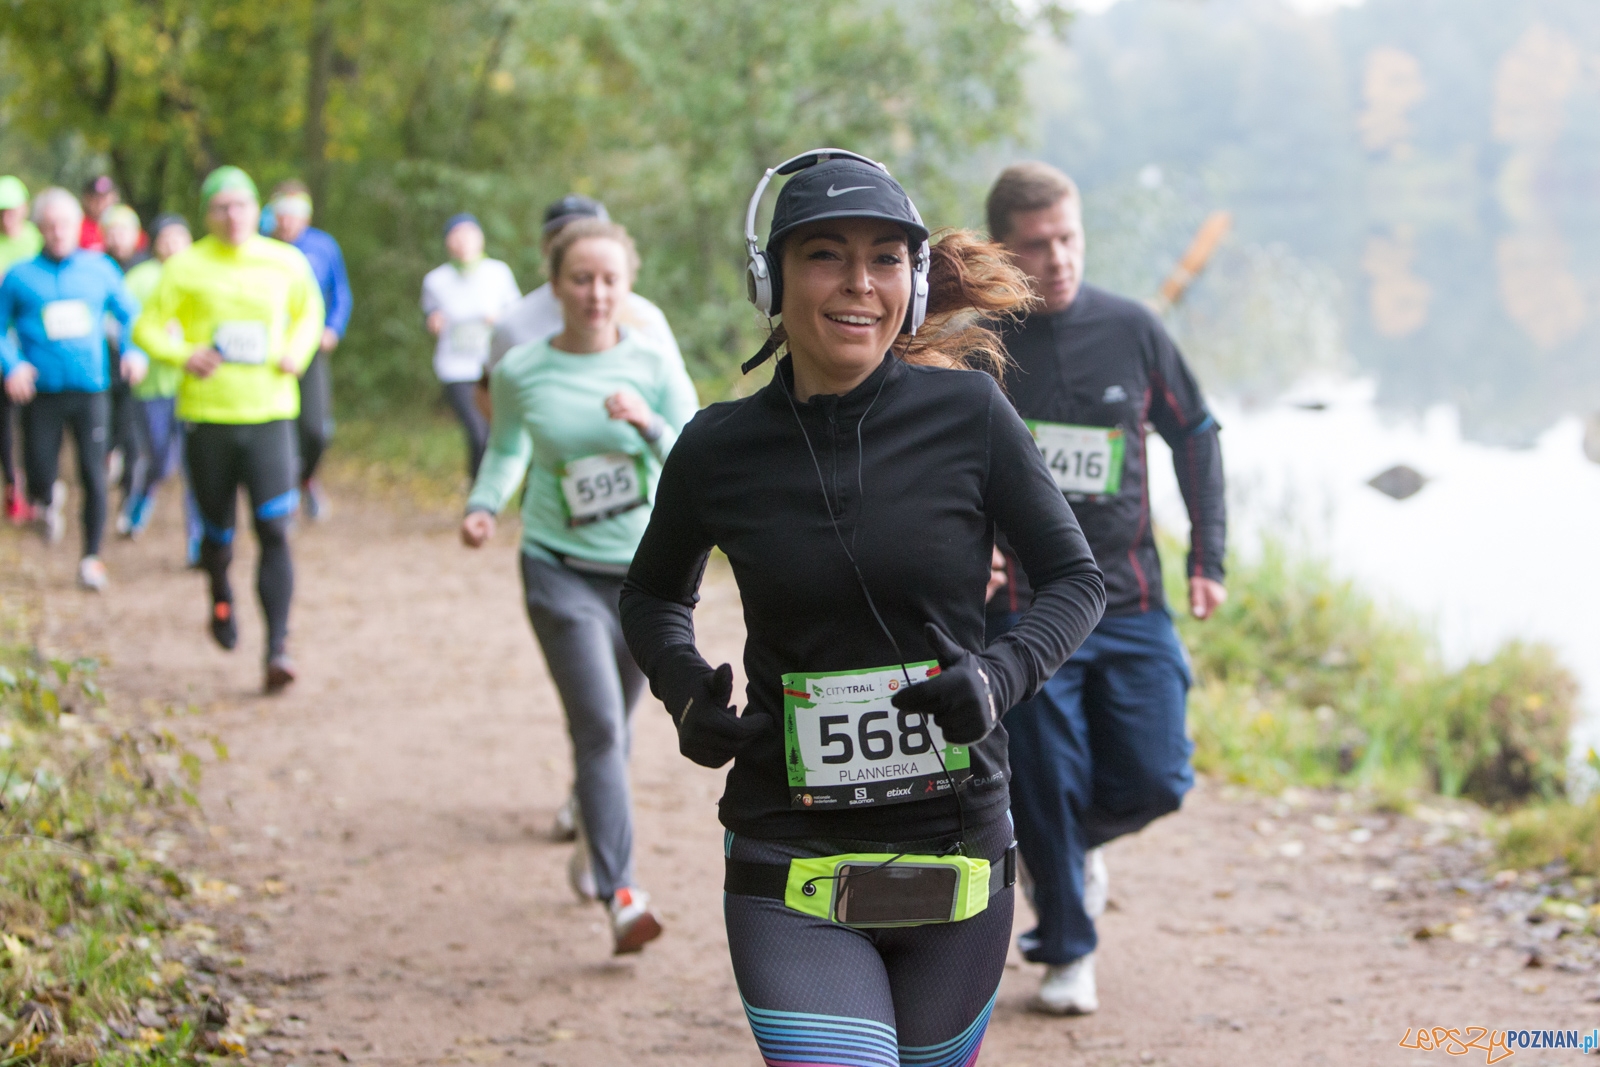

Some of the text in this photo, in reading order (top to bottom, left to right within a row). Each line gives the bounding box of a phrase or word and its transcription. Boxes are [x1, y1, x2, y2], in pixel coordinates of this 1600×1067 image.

[577, 466, 632, 503] 595
[819, 711, 931, 764] 568
[839, 762, 919, 782] PLANNERKA
